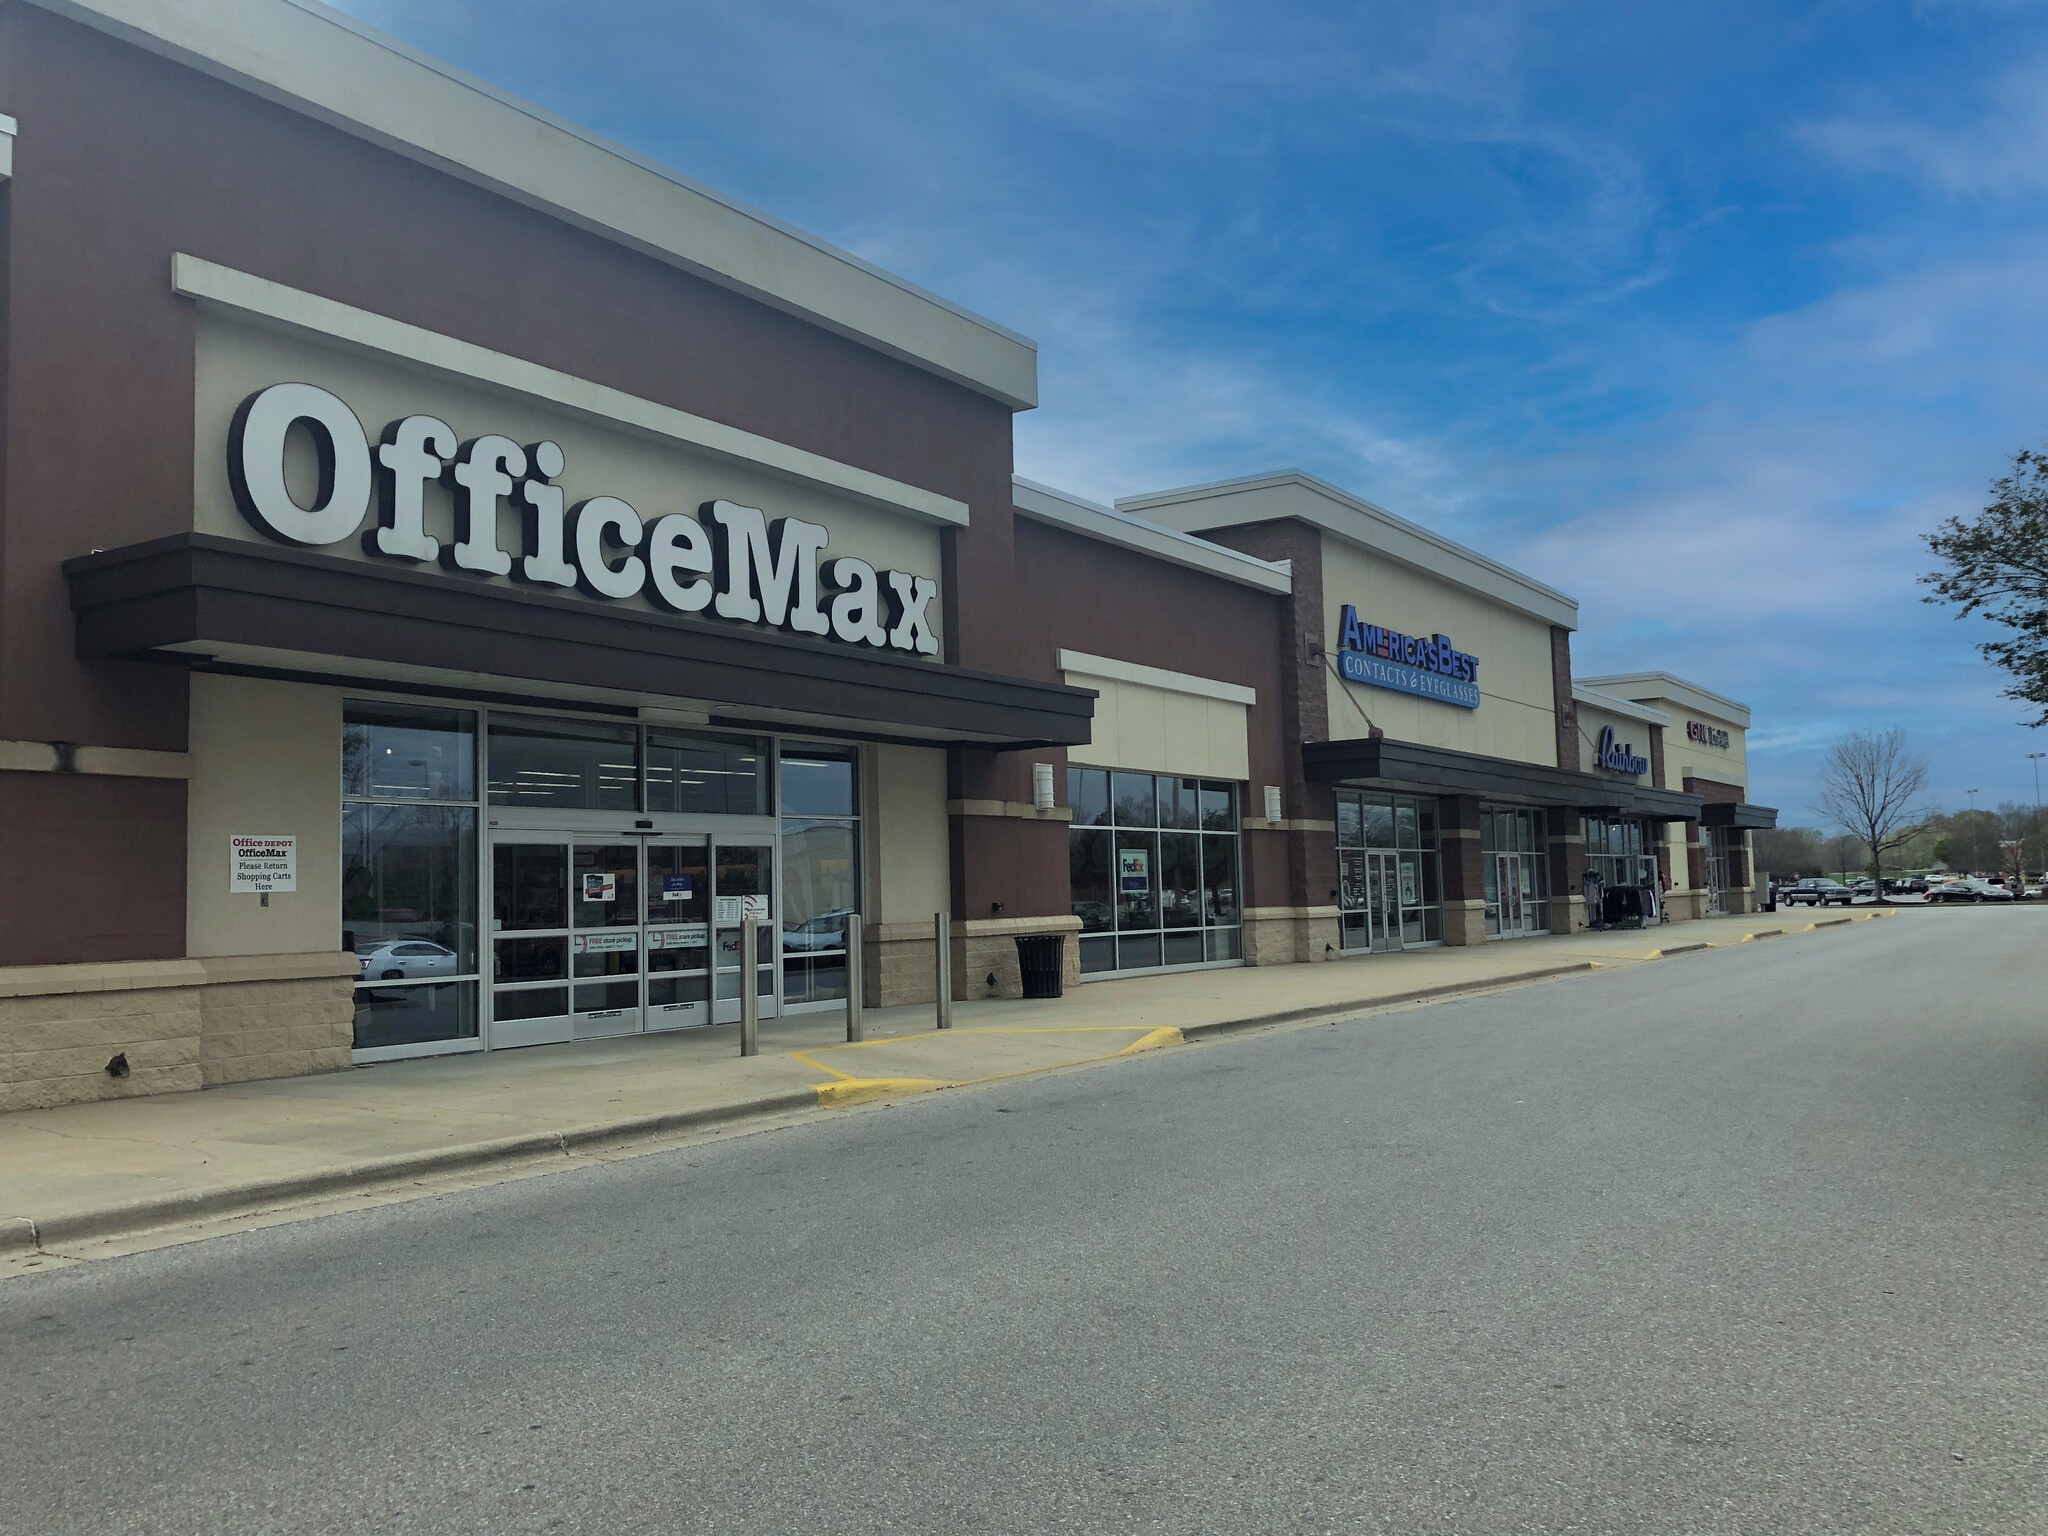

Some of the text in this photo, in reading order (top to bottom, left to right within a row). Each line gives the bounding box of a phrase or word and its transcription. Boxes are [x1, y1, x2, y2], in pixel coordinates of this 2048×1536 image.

[228, 382, 940, 655] OfficeMax
[1345, 655, 1407, 686] CONTACTS
[1420, 674, 1479, 704] EYEGLASSES
[1600, 724, 1648, 775] Rainbow
[232, 838, 263, 847] Office
[238, 848, 287, 858] OfficeMax
[239, 861, 288, 870] Please Return
[1122, 858, 1144, 873] FedEx
[236, 871, 292, 881] Shopping Carts
[255, 882, 273, 891] Here
